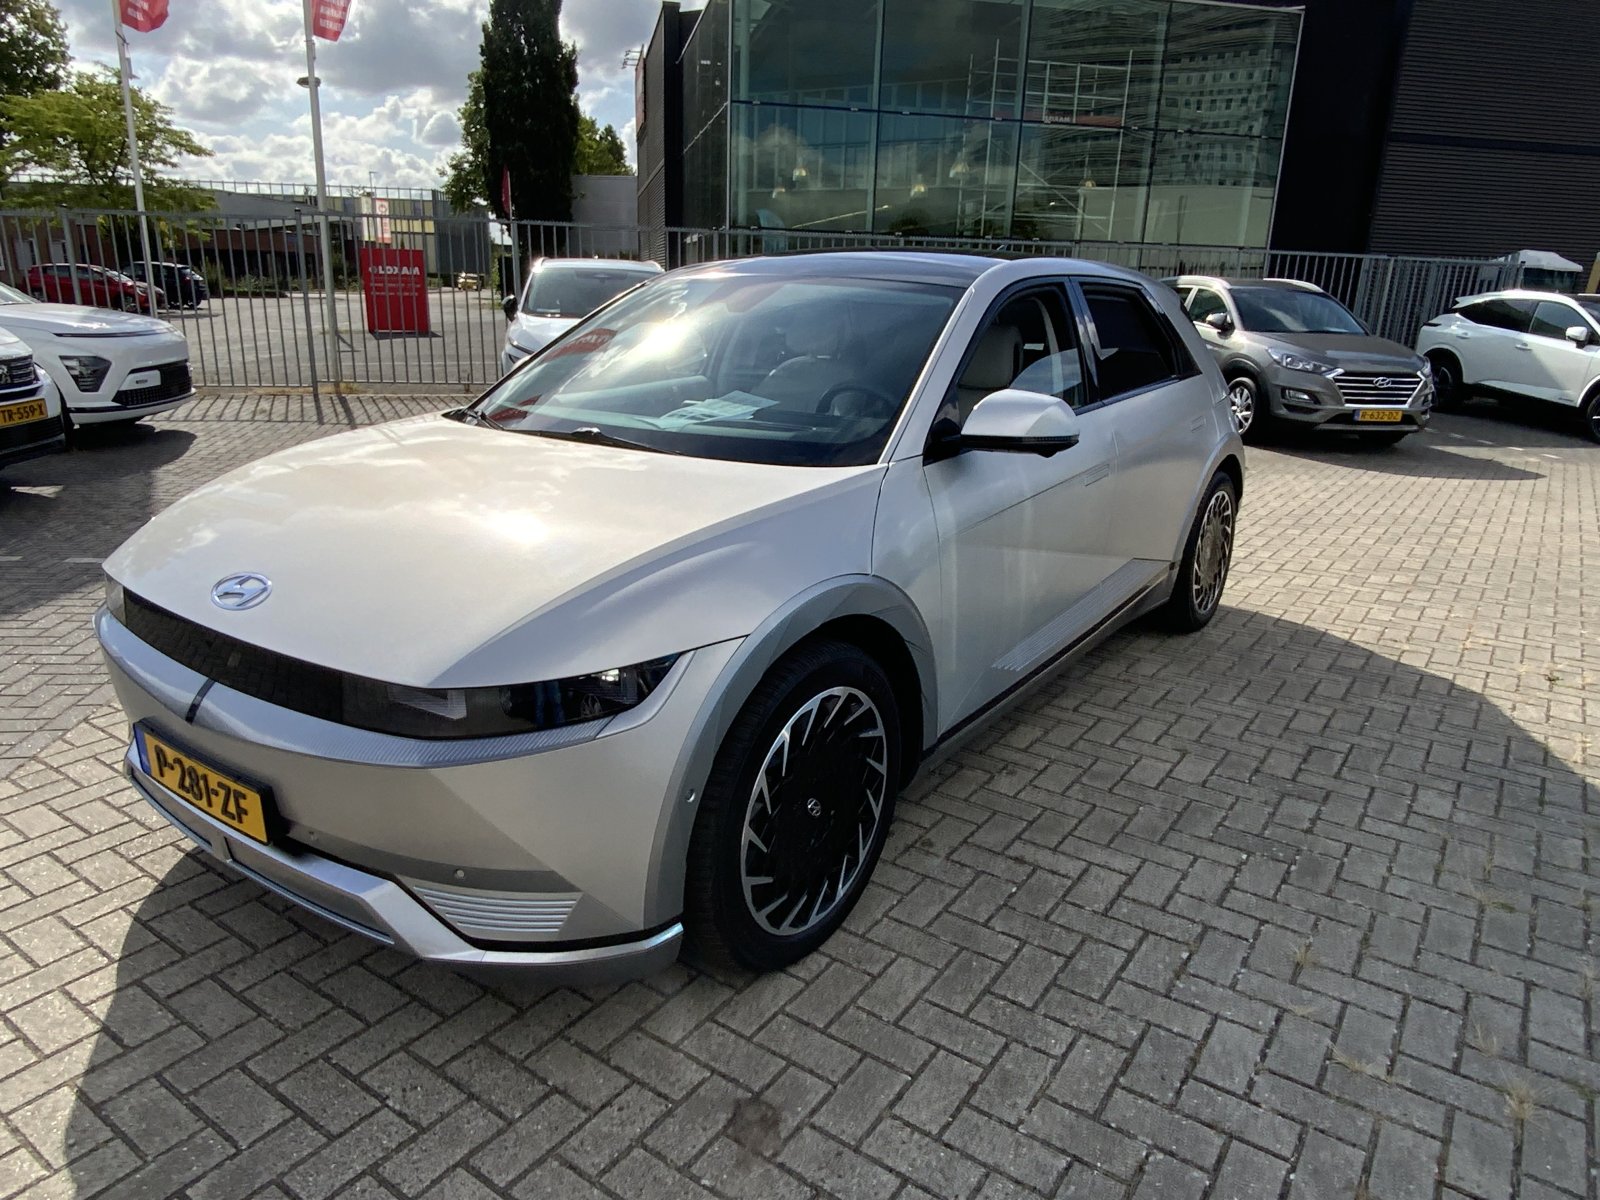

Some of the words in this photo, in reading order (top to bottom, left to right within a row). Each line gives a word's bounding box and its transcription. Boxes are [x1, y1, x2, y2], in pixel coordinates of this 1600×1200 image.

[0, 403, 45, 423] TR-559-X
[1360, 411, 1400, 420] R-632-DZ
[154, 744, 249, 824] P-281-ZF
